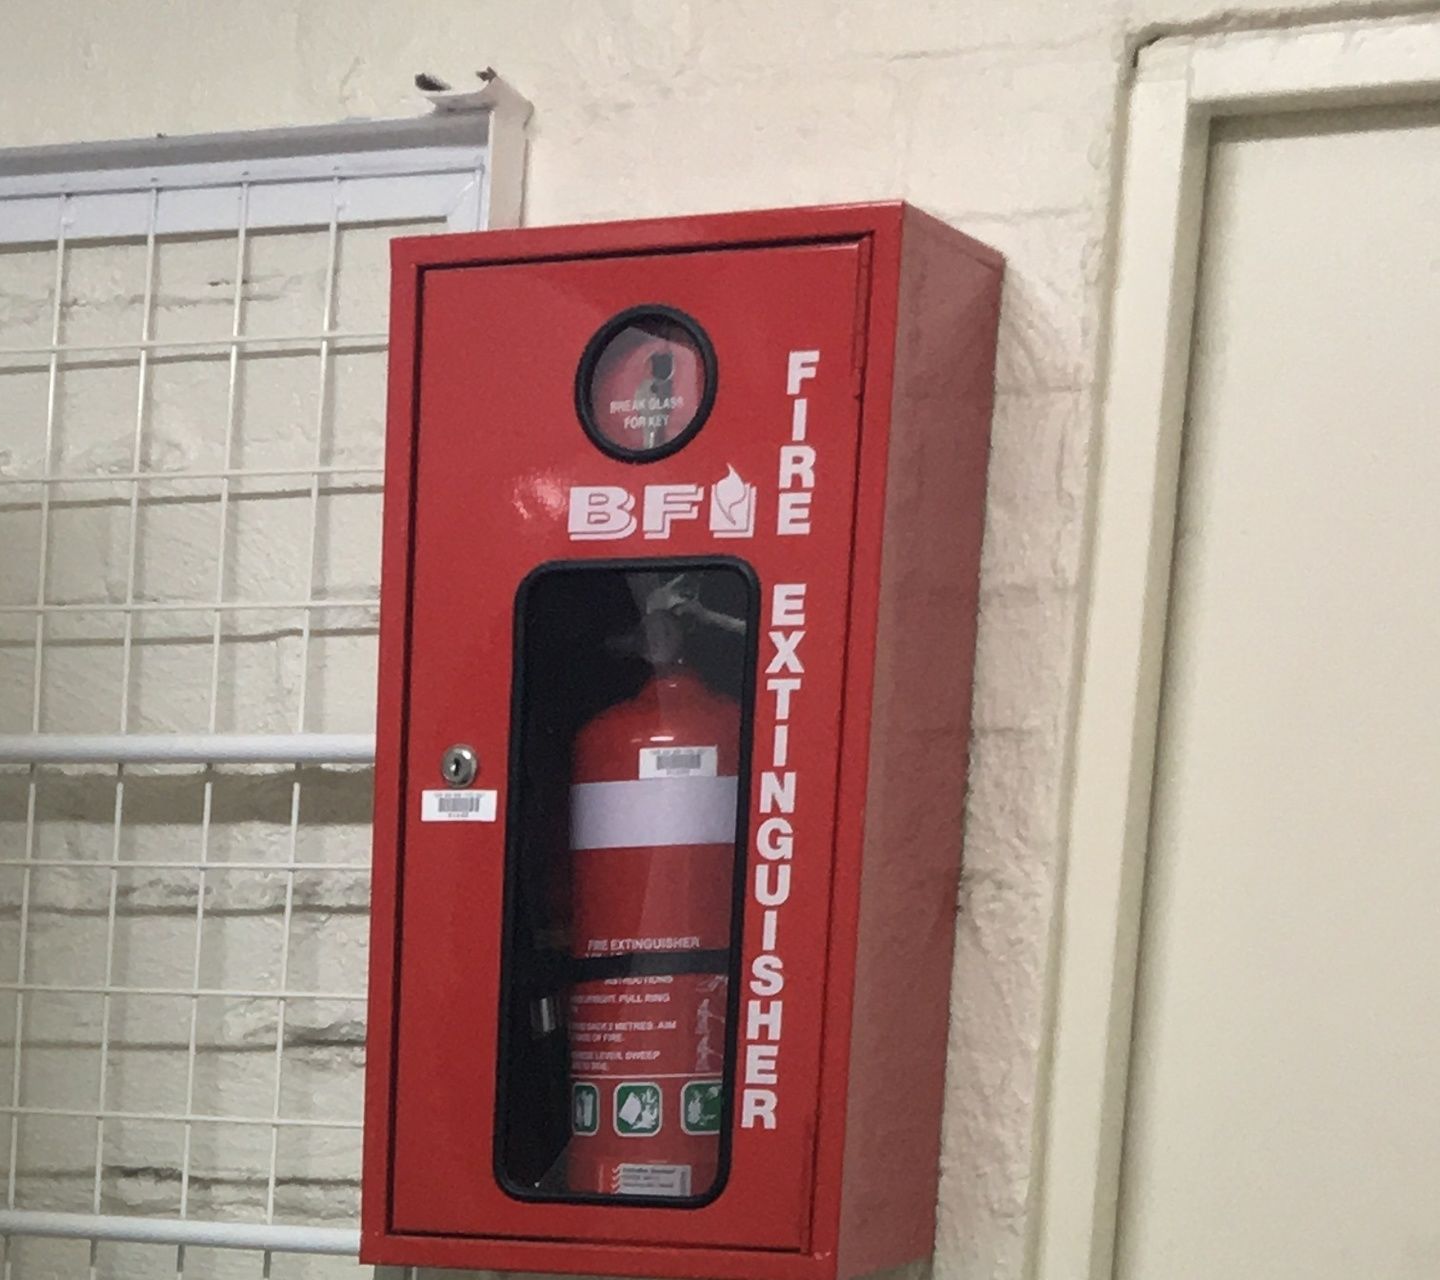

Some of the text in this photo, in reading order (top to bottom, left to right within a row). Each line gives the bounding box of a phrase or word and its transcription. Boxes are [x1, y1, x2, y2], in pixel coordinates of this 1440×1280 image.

[609, 396, 684, 414] BREAK GLASS
[623, 414, 669, 429] FOR KEY
[742, 350, 820, 1130] FIRE EXTINGUISHER
[588, 937, 700, 951] FIRE EXTINGUISHER
